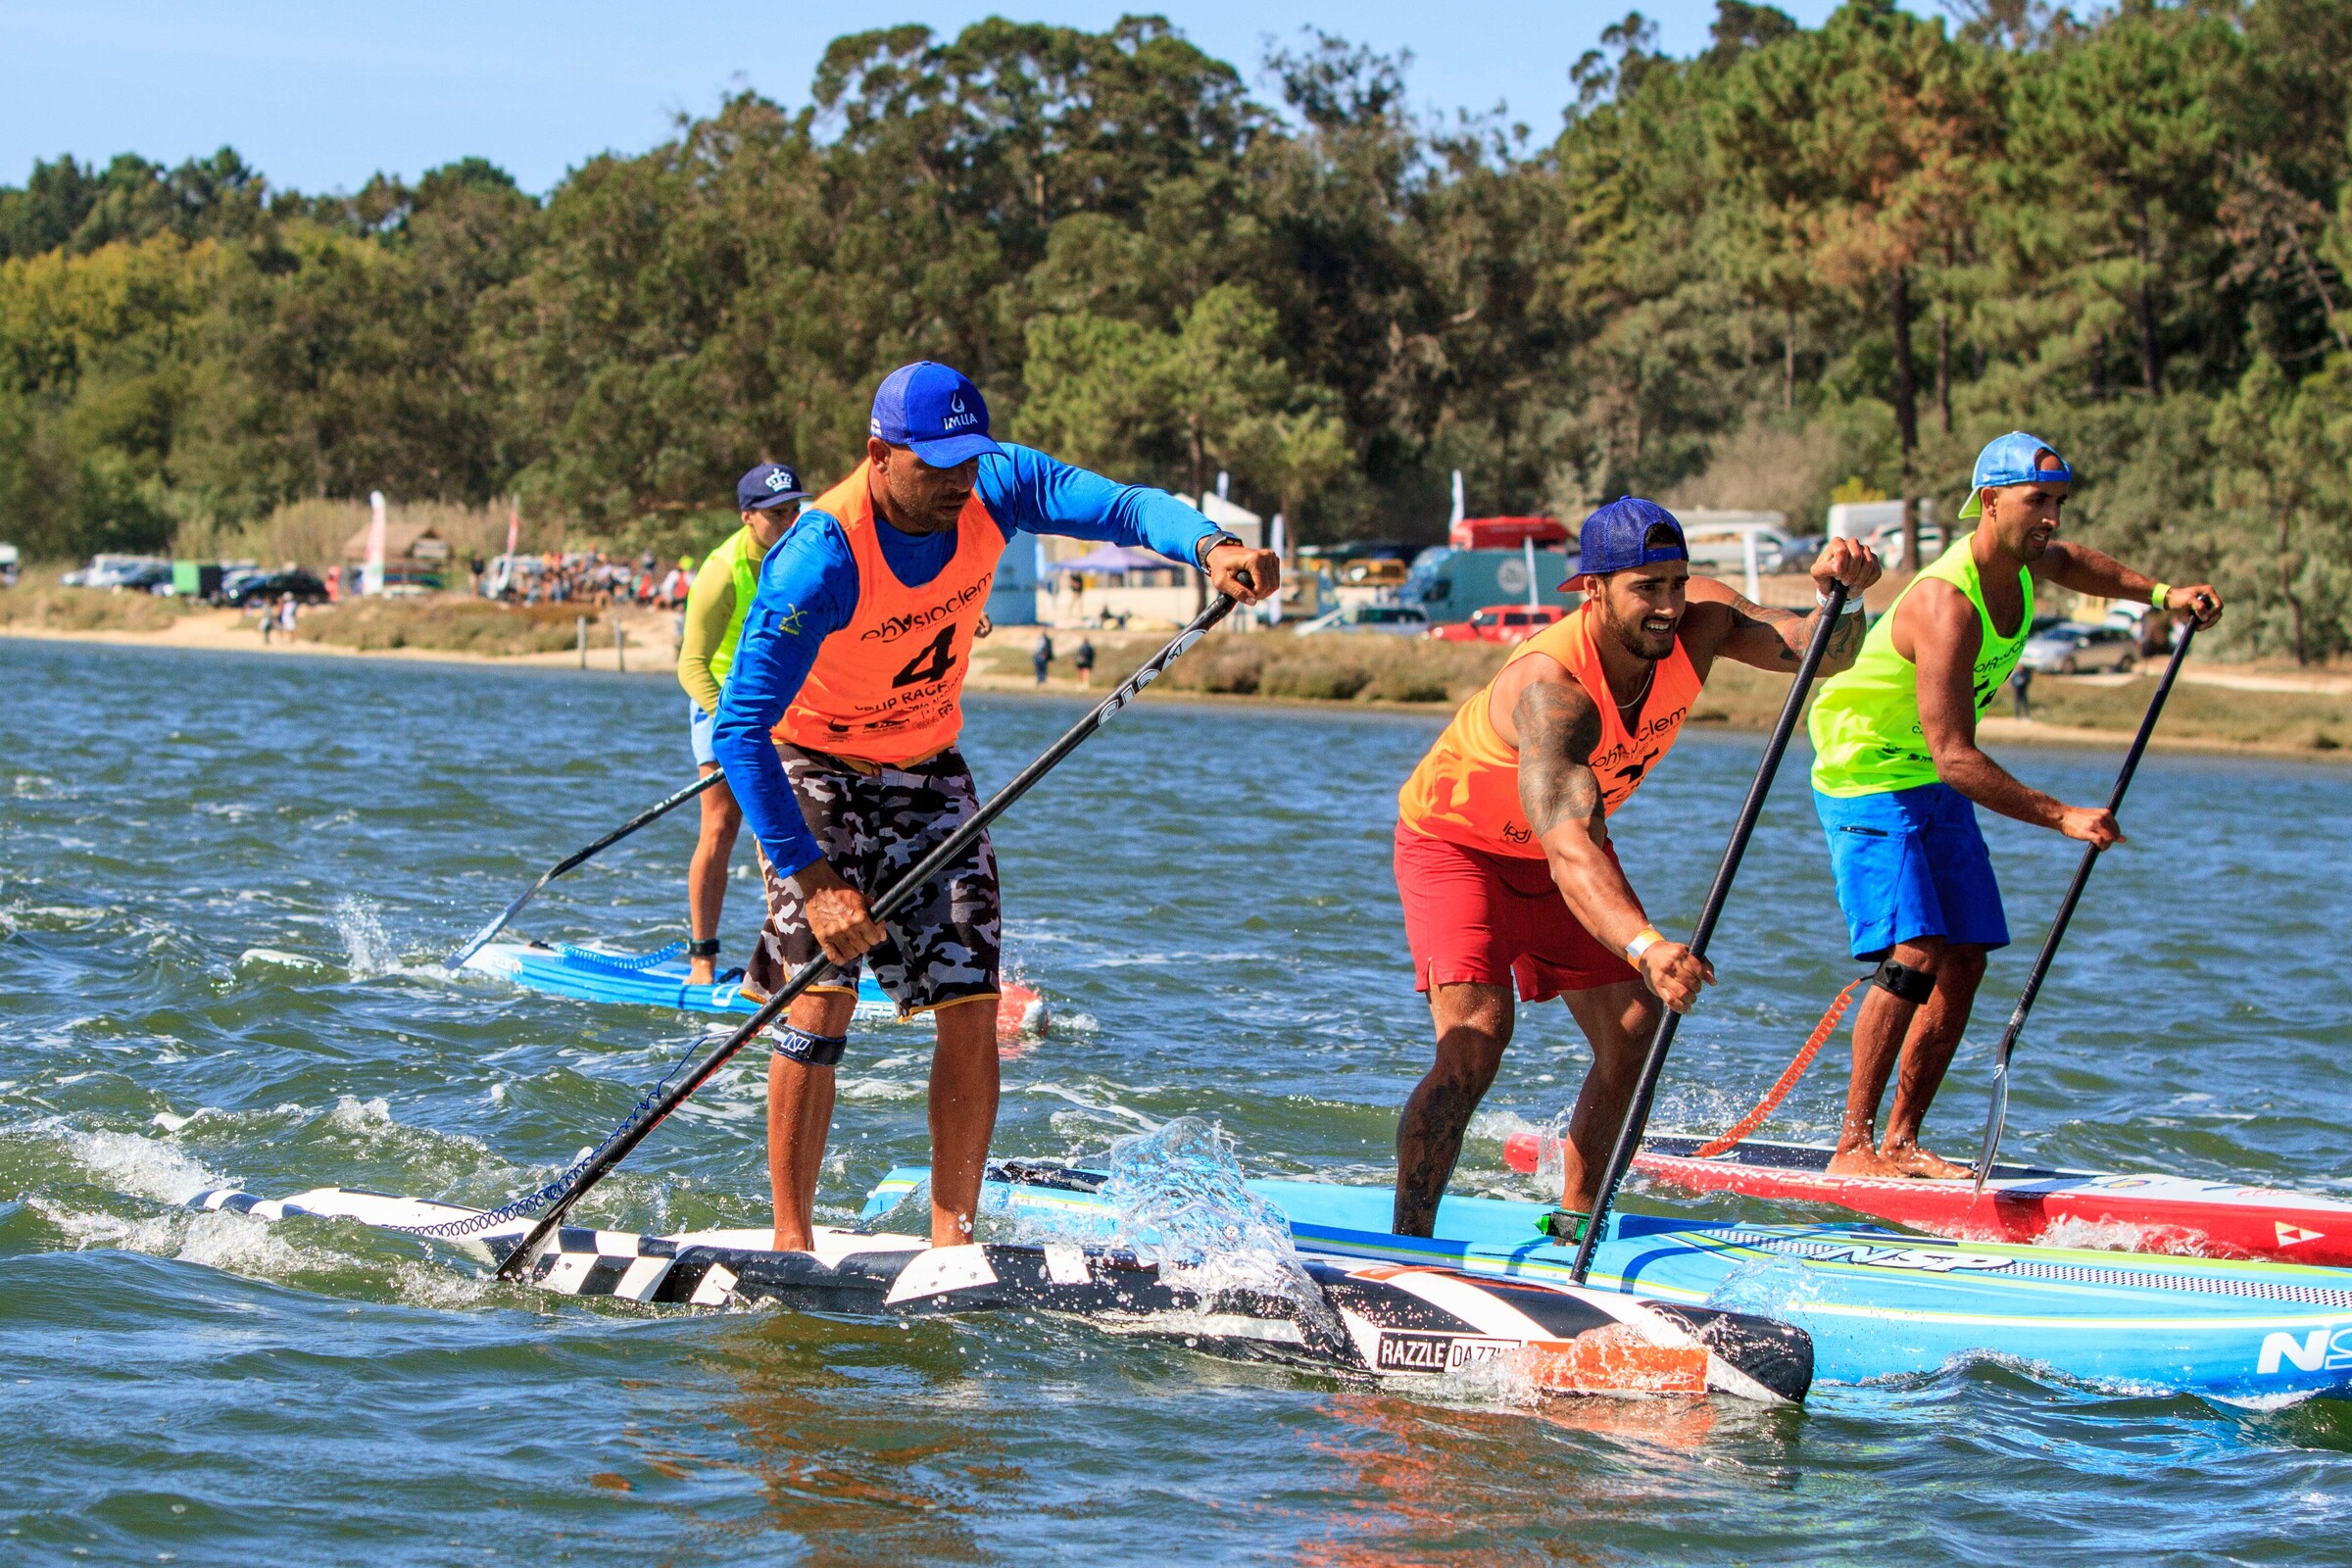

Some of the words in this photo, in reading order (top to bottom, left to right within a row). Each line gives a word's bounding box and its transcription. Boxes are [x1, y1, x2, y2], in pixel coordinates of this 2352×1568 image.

[944, 413, 978, 430] IMUA
[892, 621, 957, 689] 4
[1809, 1244, 2016, 1273] NSP
[1382, 1339, 1446, 1368] RAZZLE
